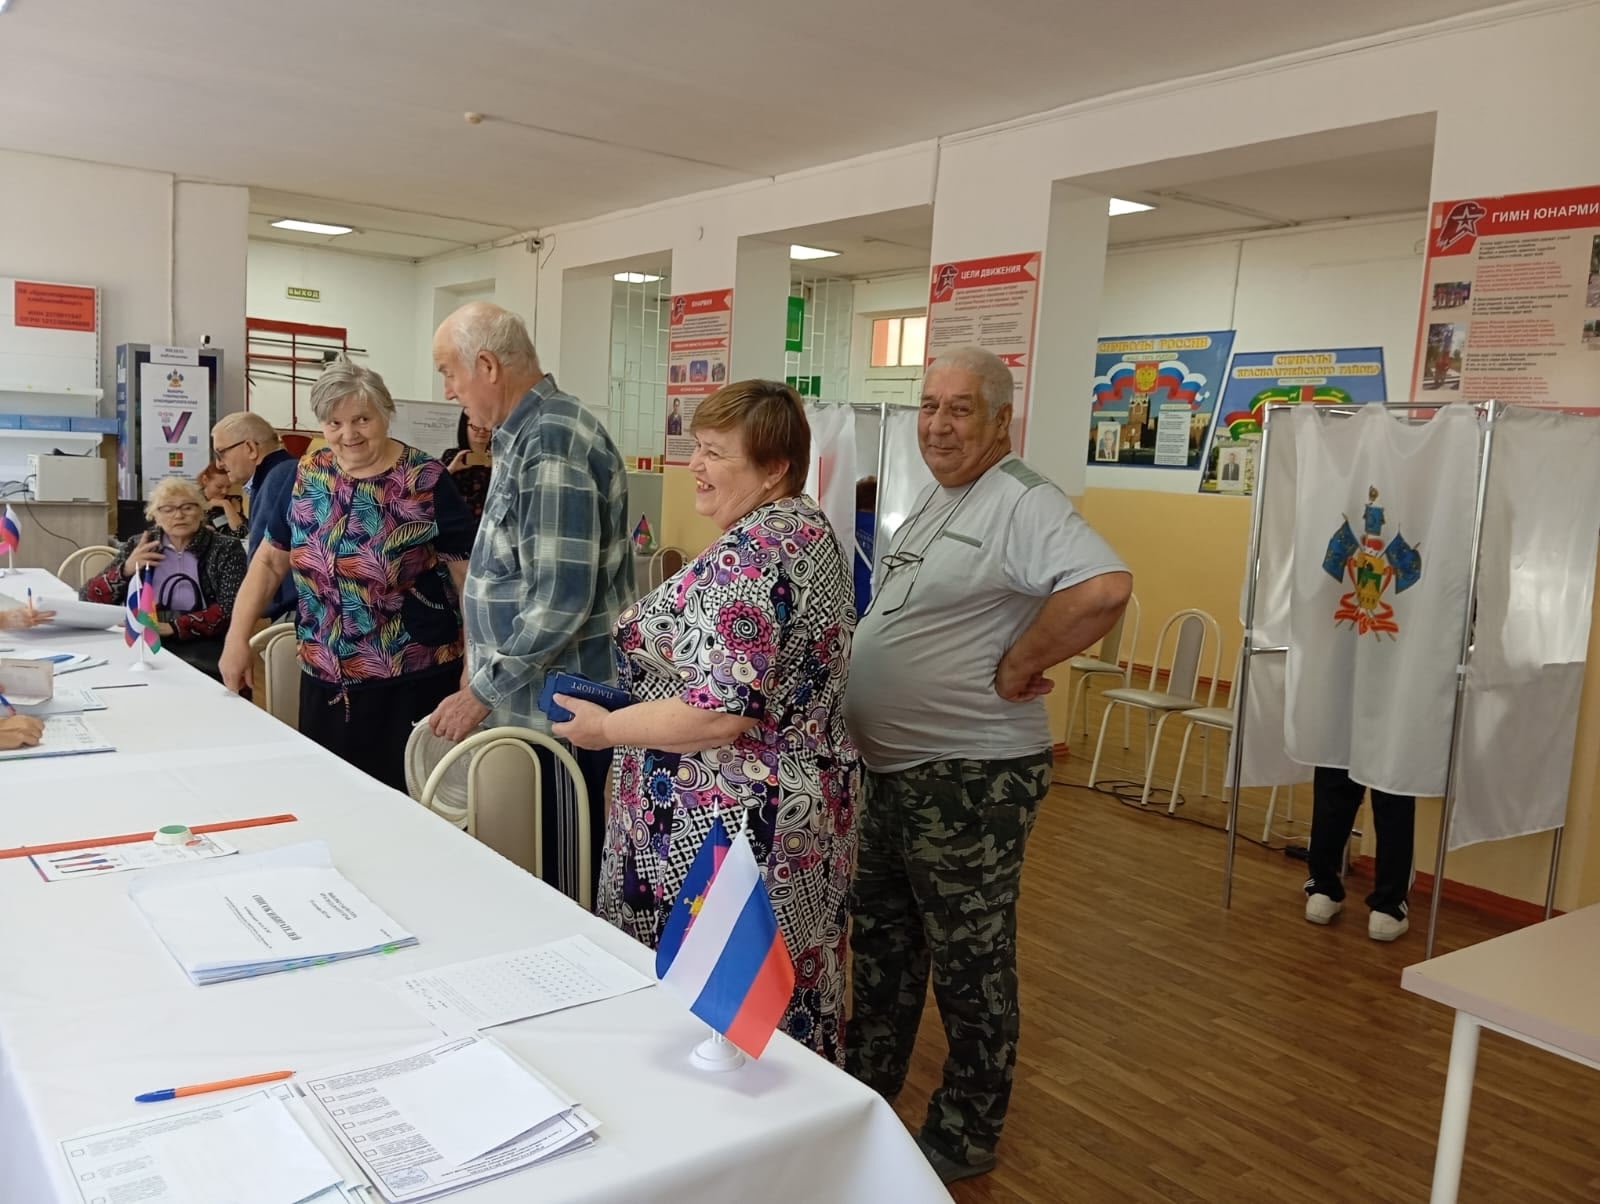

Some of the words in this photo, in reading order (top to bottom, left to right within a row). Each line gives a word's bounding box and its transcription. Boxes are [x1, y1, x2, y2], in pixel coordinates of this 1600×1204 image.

[1491, 209, 1530, 223] ГИМН
[960, 269, 980, 280] ЦЕЛИ
[980, 264, 1022, 278] ДВИЖЕНИЯ
[288, 288, 320, 298] ВЫХОД
